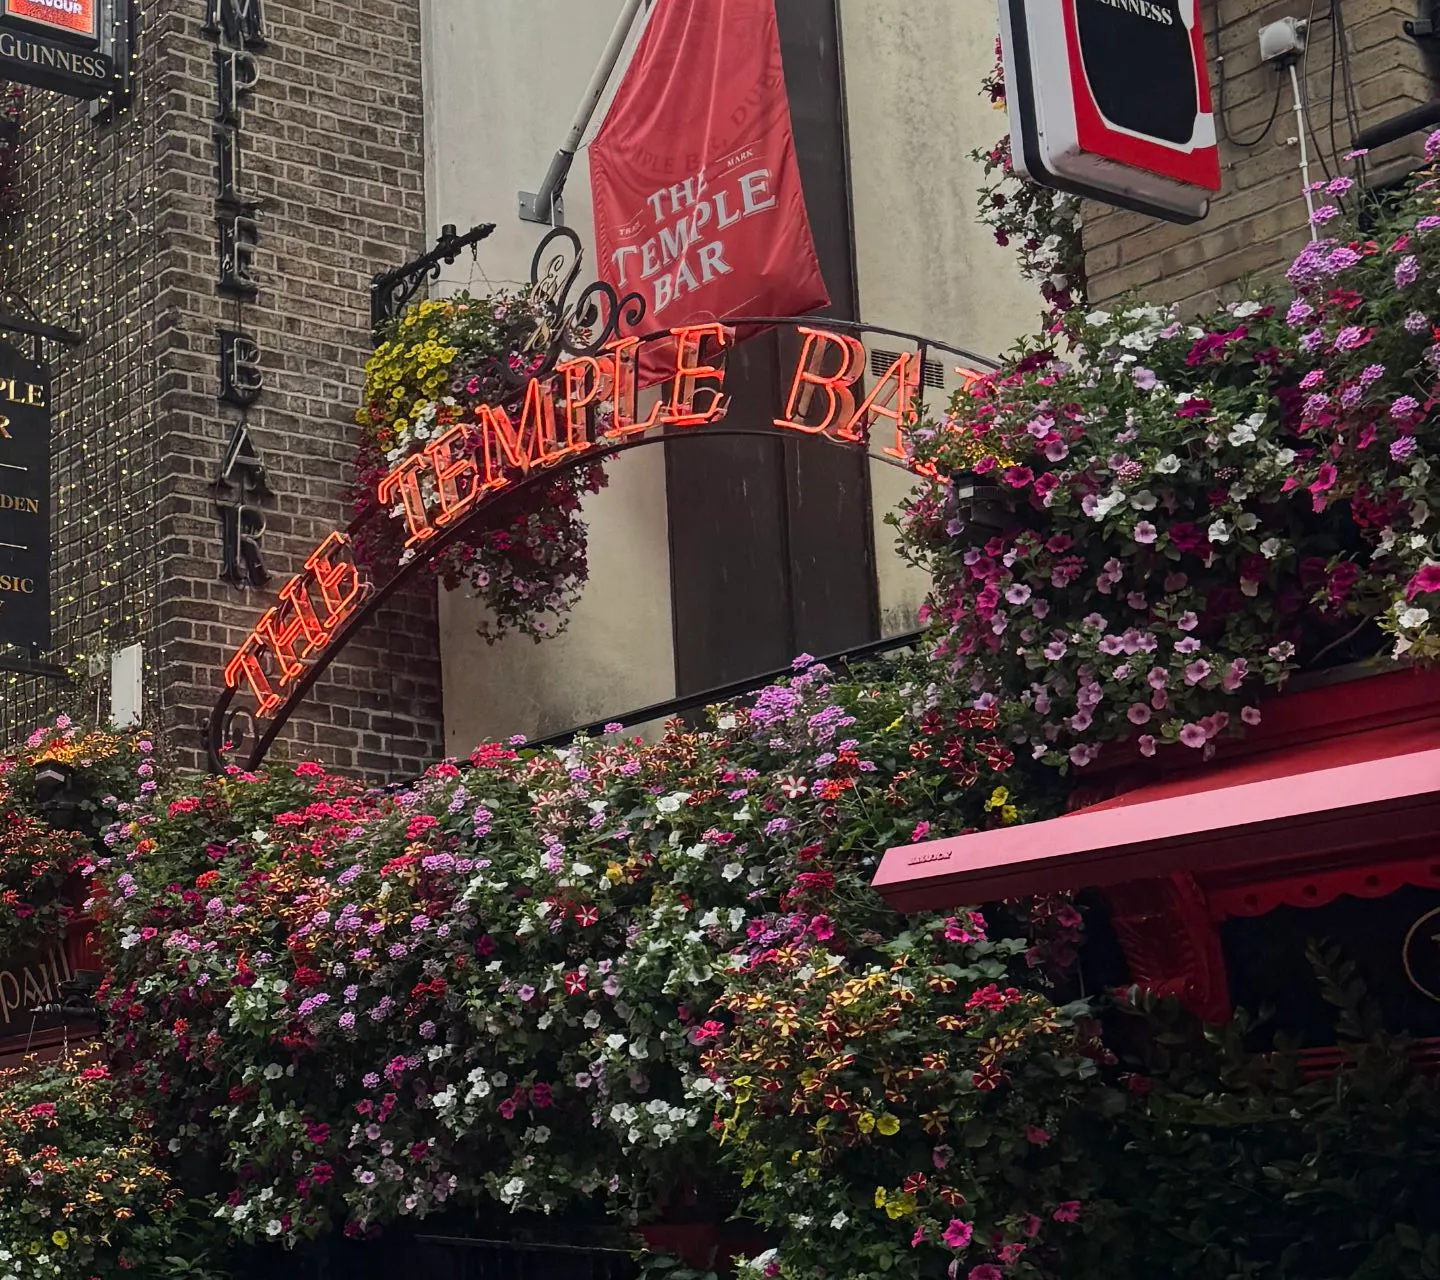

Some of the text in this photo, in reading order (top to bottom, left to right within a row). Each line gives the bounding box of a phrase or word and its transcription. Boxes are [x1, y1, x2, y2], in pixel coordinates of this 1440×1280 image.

[726, 148, 754, 168] MARK
[611, 168, 779, 290] TEMPLE
[647, 171, 708, 225] THE
[652, 239, 734, 314] BAR
[224, 530, 372, 718] THE
[377, 321, 737, 549] TEMPLE
